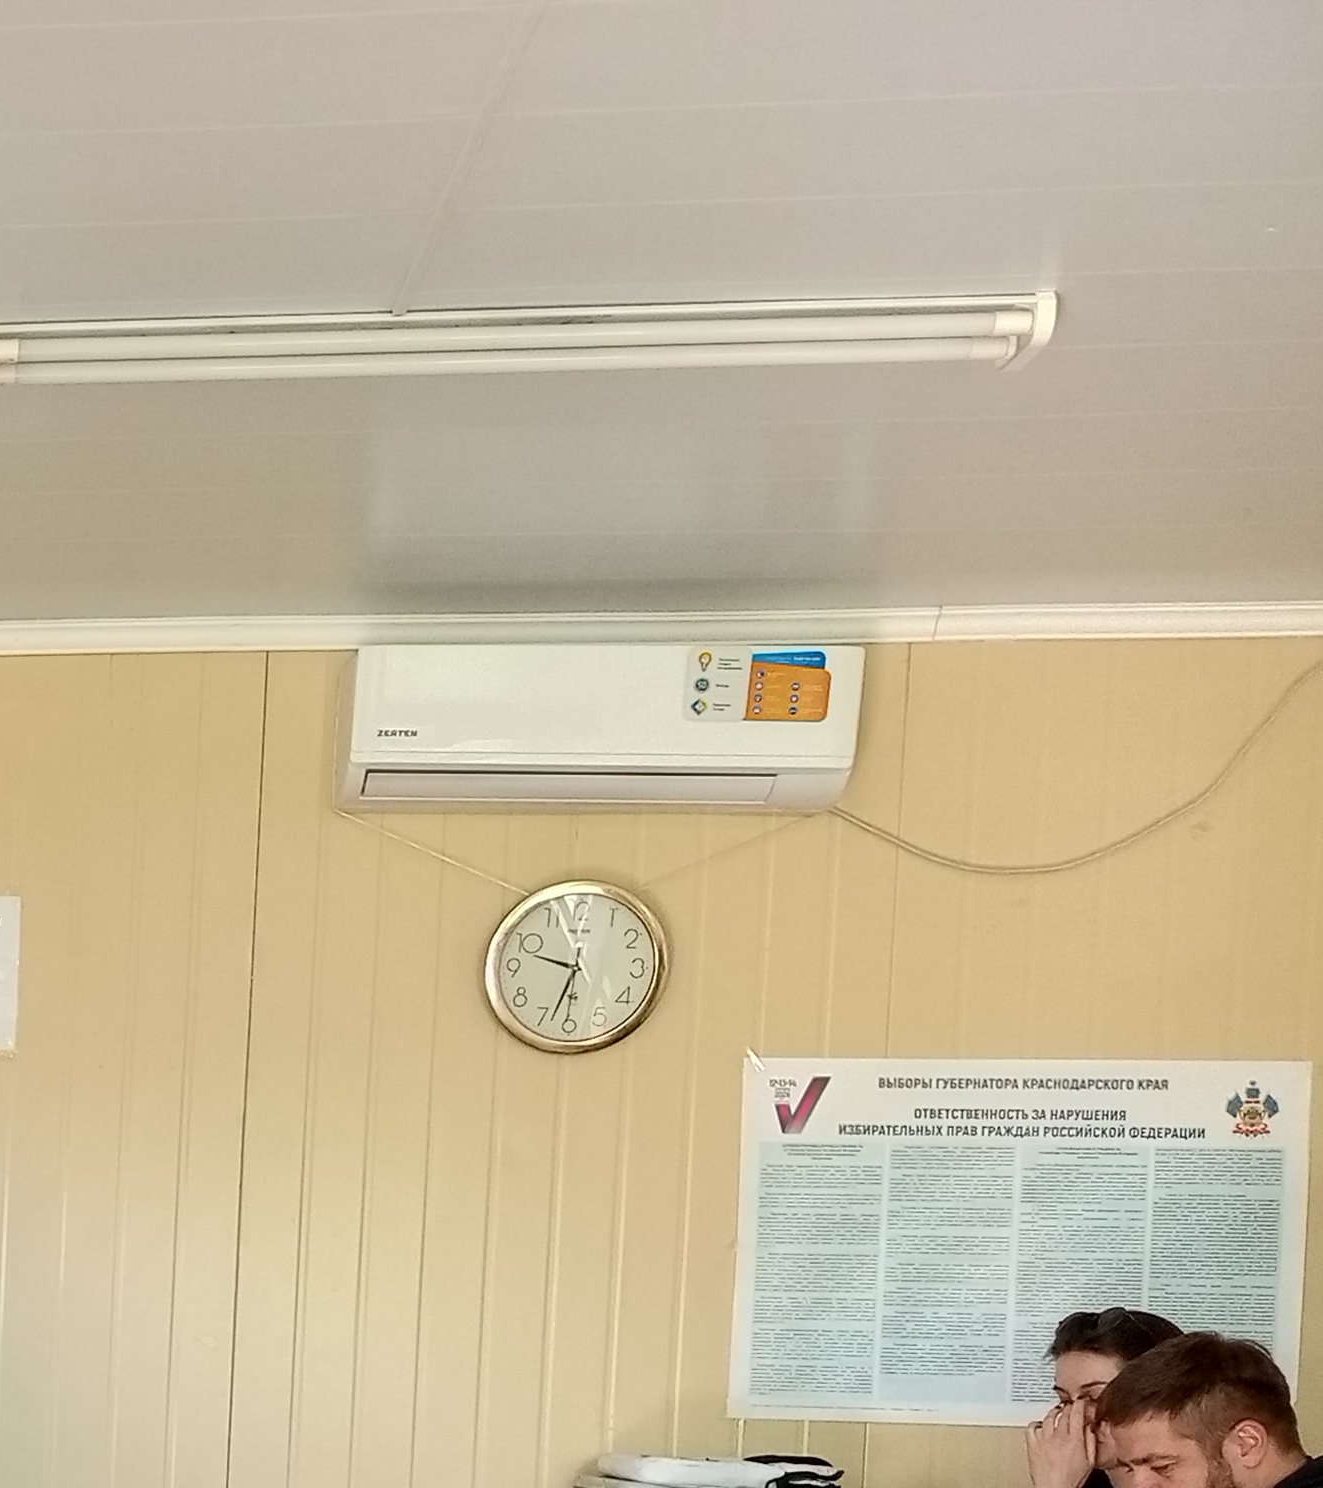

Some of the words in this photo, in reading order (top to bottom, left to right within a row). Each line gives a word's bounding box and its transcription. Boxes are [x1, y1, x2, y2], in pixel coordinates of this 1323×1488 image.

[516, 932, 544, 954] 10
[624, 928, 639, 949] 2
[506, 957, 521, 978] 9
[629, 957, 645, 979] 3
[512, 986, 528, 1008] 8
[614, 986, 633, 1005] 4
[537, 1006, 549, 1027] 7
[592, 1006, 607, 1027] 5
[878, 1077, 933, 1089] ВЫБОРЫ
[936, 1078, 1019, 1090] ГУБЕРНАТОРА
[1022, 1078, 1134, 1091] КРАСНОДАРСКОГО
[1137, 1079, 1169, 1091] КРАЯ
[913, 1108, 1029, 1120] ОТВЕТСТВЕННОСТЬ
[1031, 1109, 1046, 1120] ЗА
[1050, 1109, 1126, 1121] НАРУШЕНИЯ
[838, 1123, 943, 1136] ИЗБИРАТЕЛЬНЫХ
[946, 1125, 978, 1136] ПРАВ
[981, 1125, 1039, 1138] ГРАЖДАН
[1044, 1124, 1125, 1138] РОССИЙСКОЙ
[1129, 1126, 1206, 1140] ФЕДЕРАЦИИ
